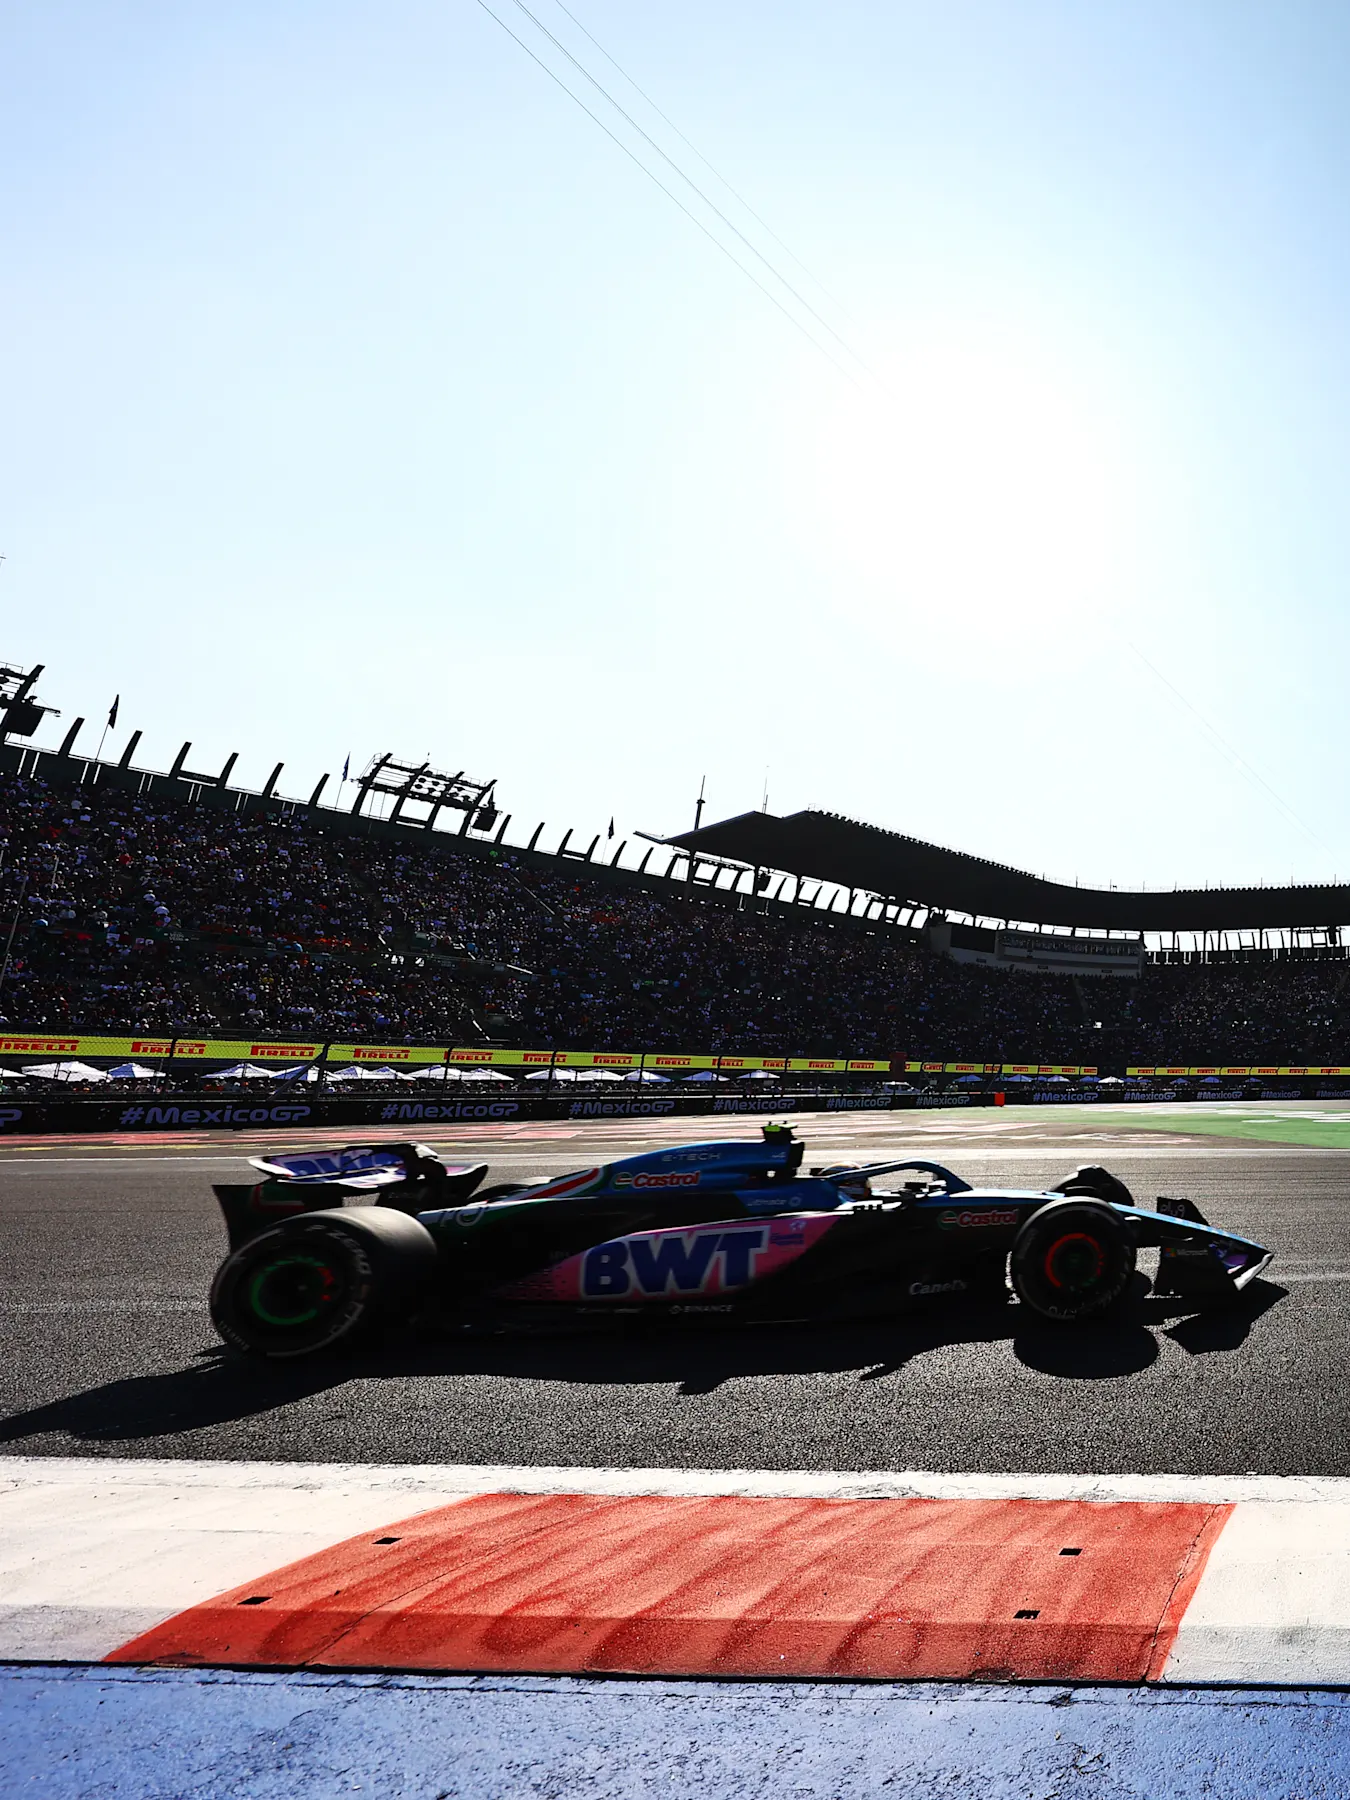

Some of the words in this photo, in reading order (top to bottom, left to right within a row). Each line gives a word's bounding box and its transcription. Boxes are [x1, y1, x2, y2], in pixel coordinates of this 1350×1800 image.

[131, 1042, 206, 1055] PIRELLI
[251, 1045, 316, 1057] PIRELLI
[353, 1047, 411, 1060] PIRELLI
[443, 1051, 494, 1062] PIRELLI
[522, 1053, 568, 1064] PIRELI
[592, 1054, 634, 1065] PIRELLI
[656, 1057, 691, 1066] PIRELLI
[826, 1096, 892, 1109] #MexicoGP
[915, 1094, 971, 1107] #MexicoGP
[1033, 1092, 1099, 1102] #MexicoGP
[1123, 1091, 1177, 1101] #MexicoGP
[380, 1102, 519, 1120] #MexicoGP
[568, 1099, 675, 1115] #MexicoGP
[712, 1098, 796, 1112] #MexicoGP
[119, 1104, 312, 1125] #MexicoGP
[633, 1171, 701, 1189] Castrol
[1159, 1203, 1186, 1219] plug
[958, 1208, 1019, 1228] Castrol
[582, 1223, 770, 1301] BWT
[908, 1278, 969, 1297] Canel's
